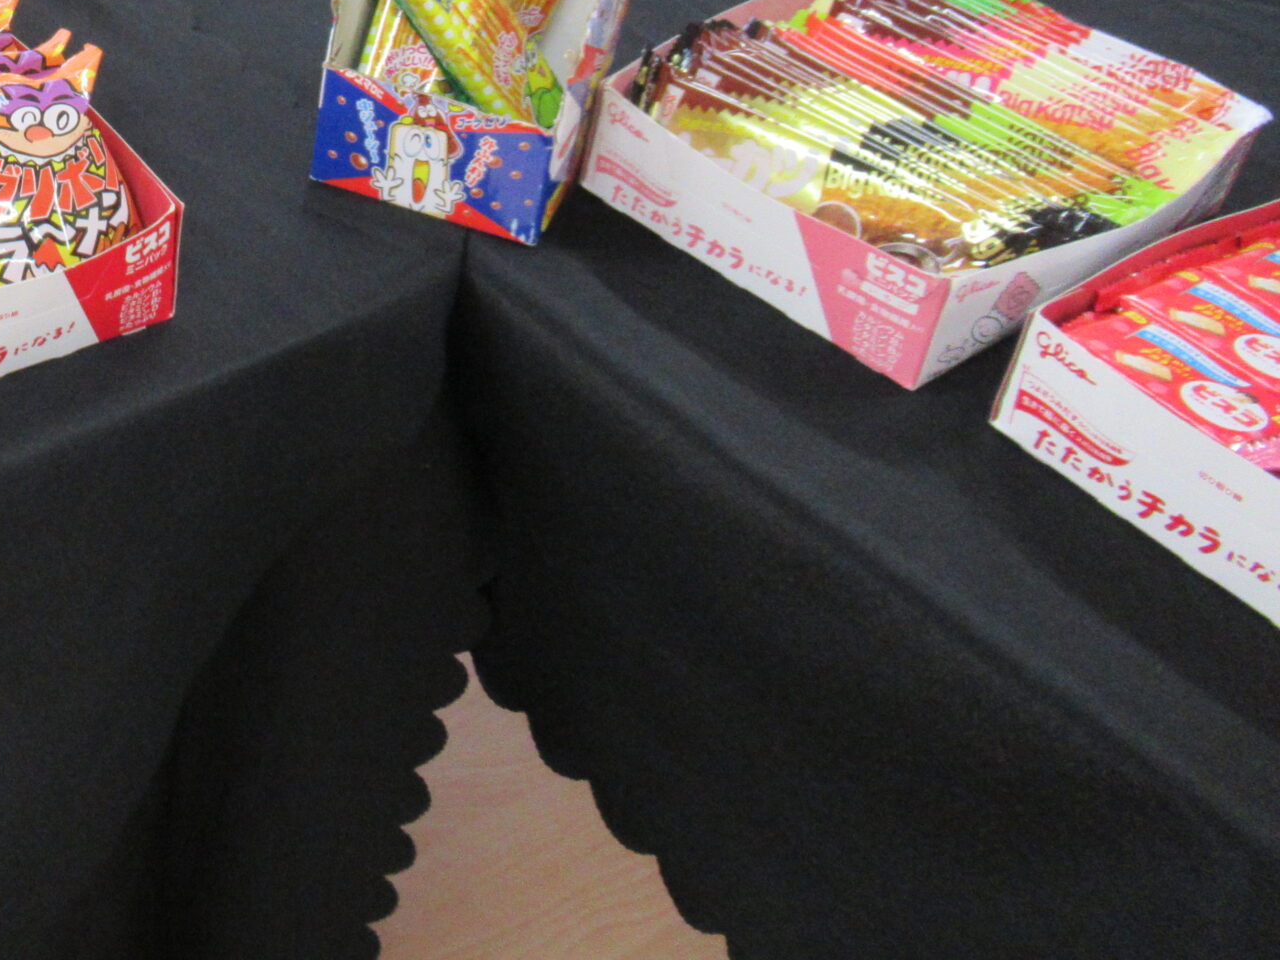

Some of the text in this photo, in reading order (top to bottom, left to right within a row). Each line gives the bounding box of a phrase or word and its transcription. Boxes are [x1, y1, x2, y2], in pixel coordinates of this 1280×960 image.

[124, 220, 172, 264] ビスコ
[611, 184, 808, 297] たたかうチカラになる!
[865, 251, 928, 298] ビスコ
[1035, 331, 1098, 386] Glico
[1190, 383, 1261, 428] ビスコ
[1033, 428, 1280, 593] たたかうチカラにな
